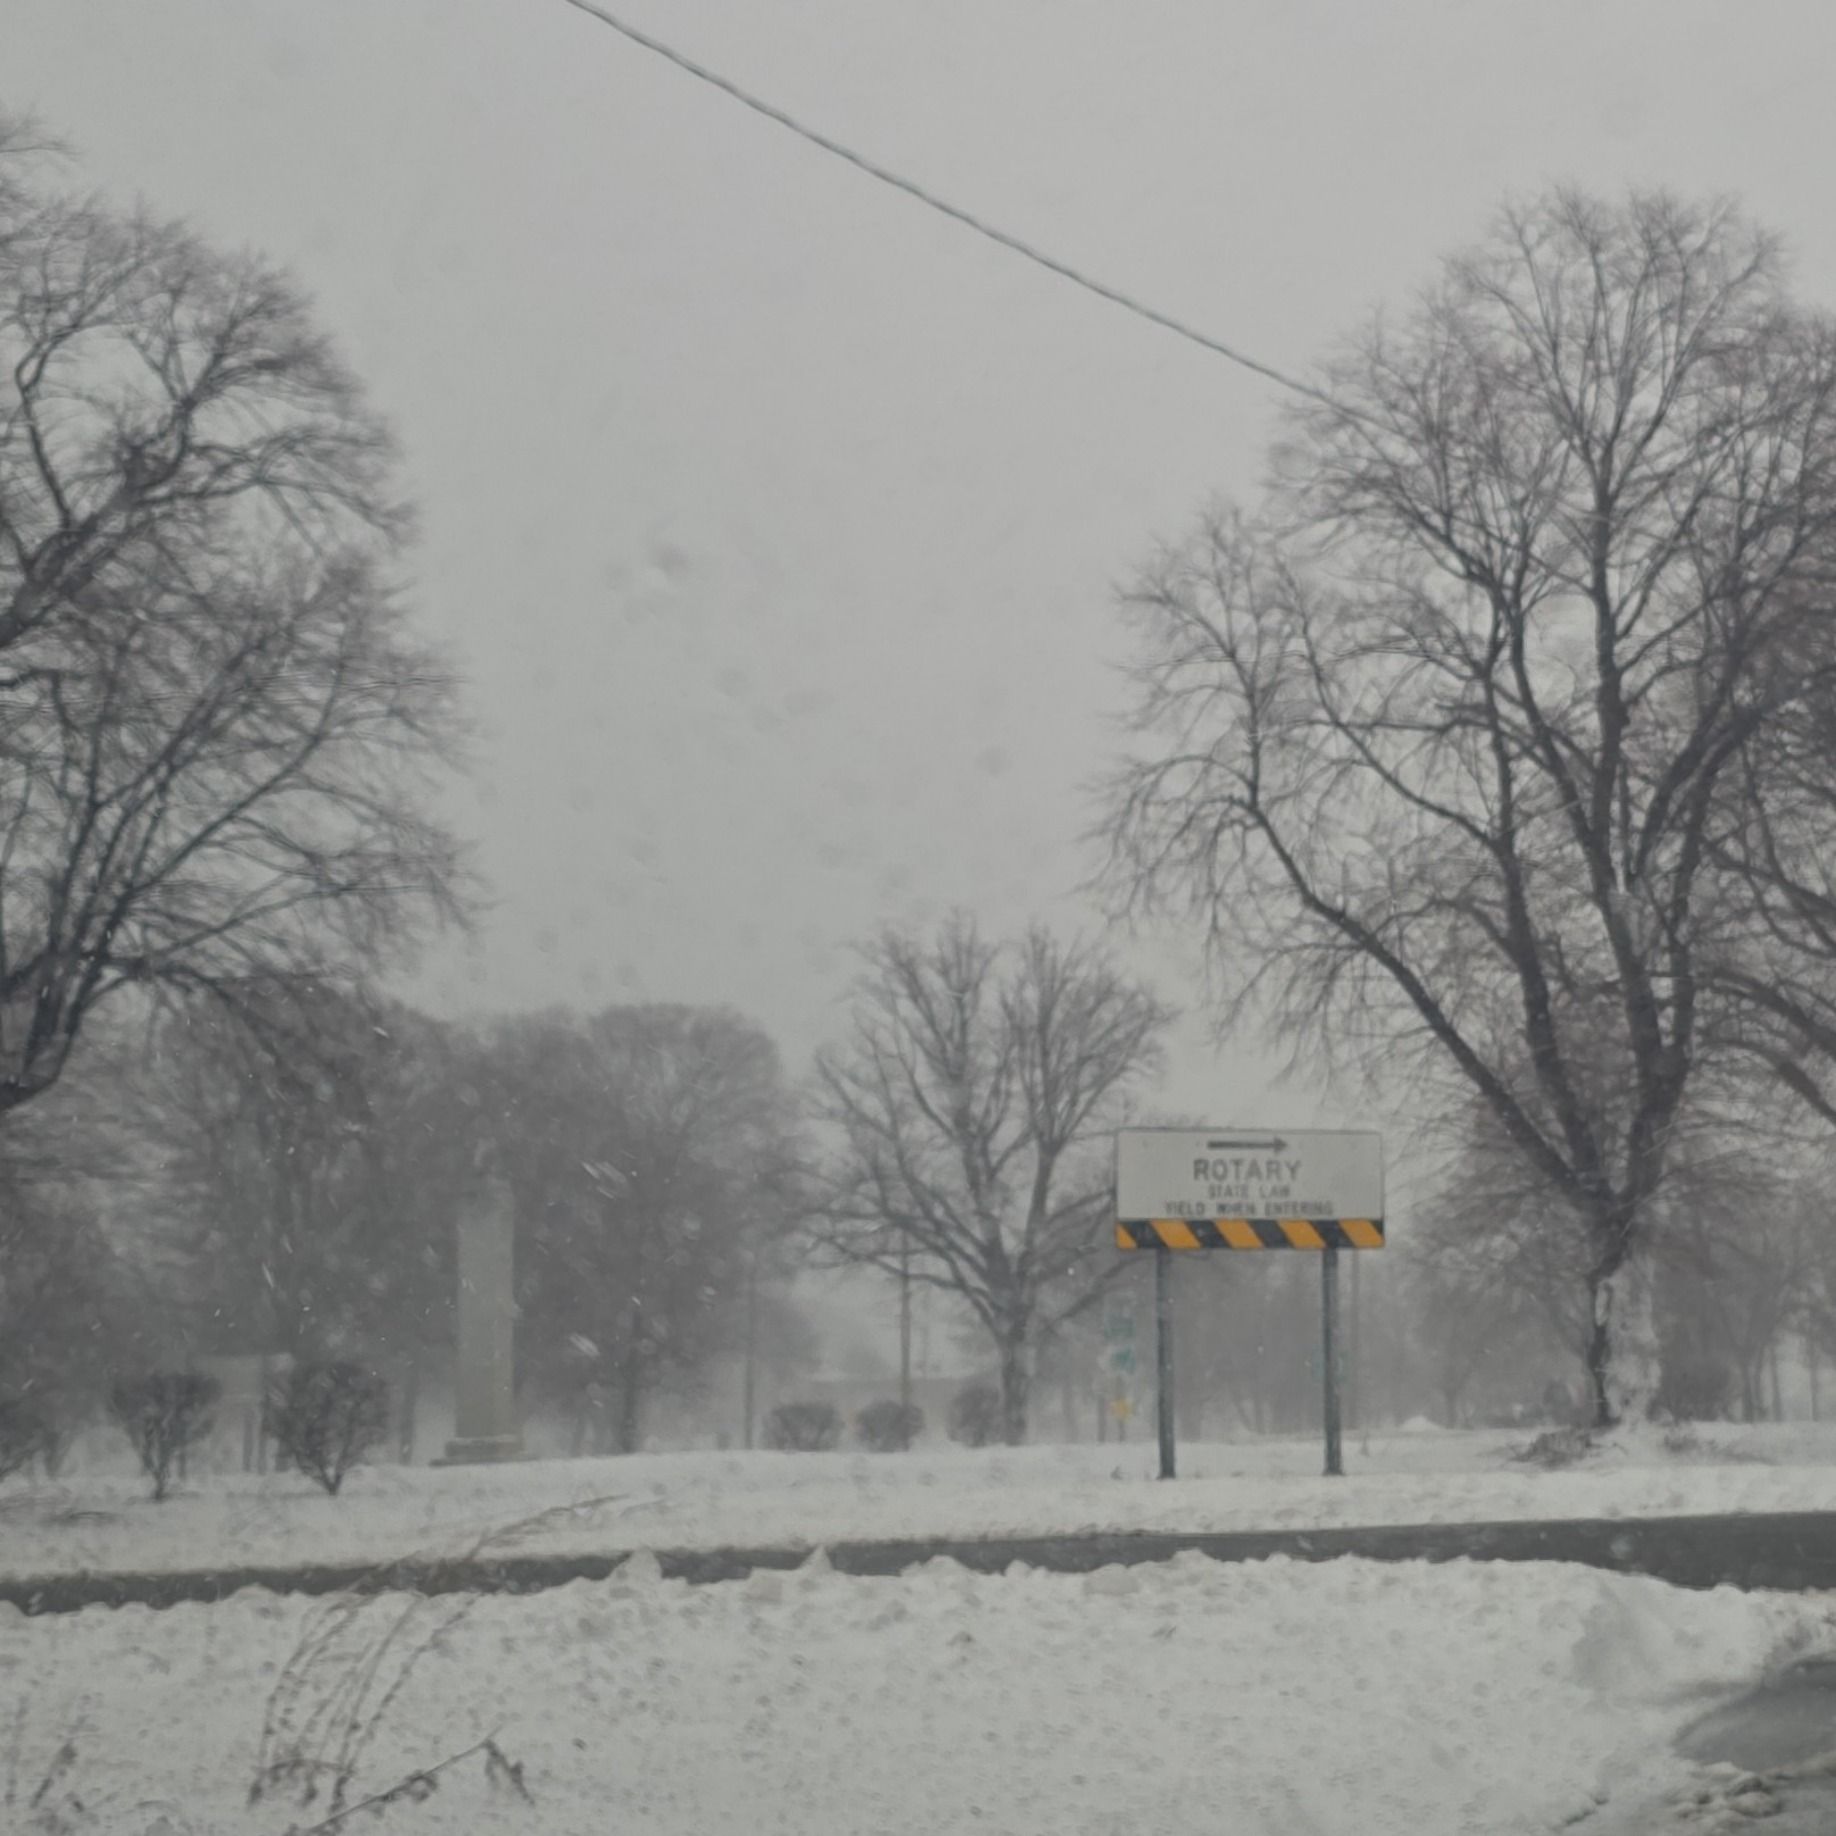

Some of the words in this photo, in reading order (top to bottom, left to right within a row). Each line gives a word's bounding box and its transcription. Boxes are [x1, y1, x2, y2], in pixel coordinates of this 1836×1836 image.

[1193, 1159, 1301, 1181] ROTARY
[1208, 1185, 1249, 1198] STATE
[1260, 1185, 1291, 1198] LAW
[1165, 1202, 1205, 1215] YIELD
[1216, 1202, 1256, 1215] WHEN
[1265, 1202, 1333, 1216] ENTERING
